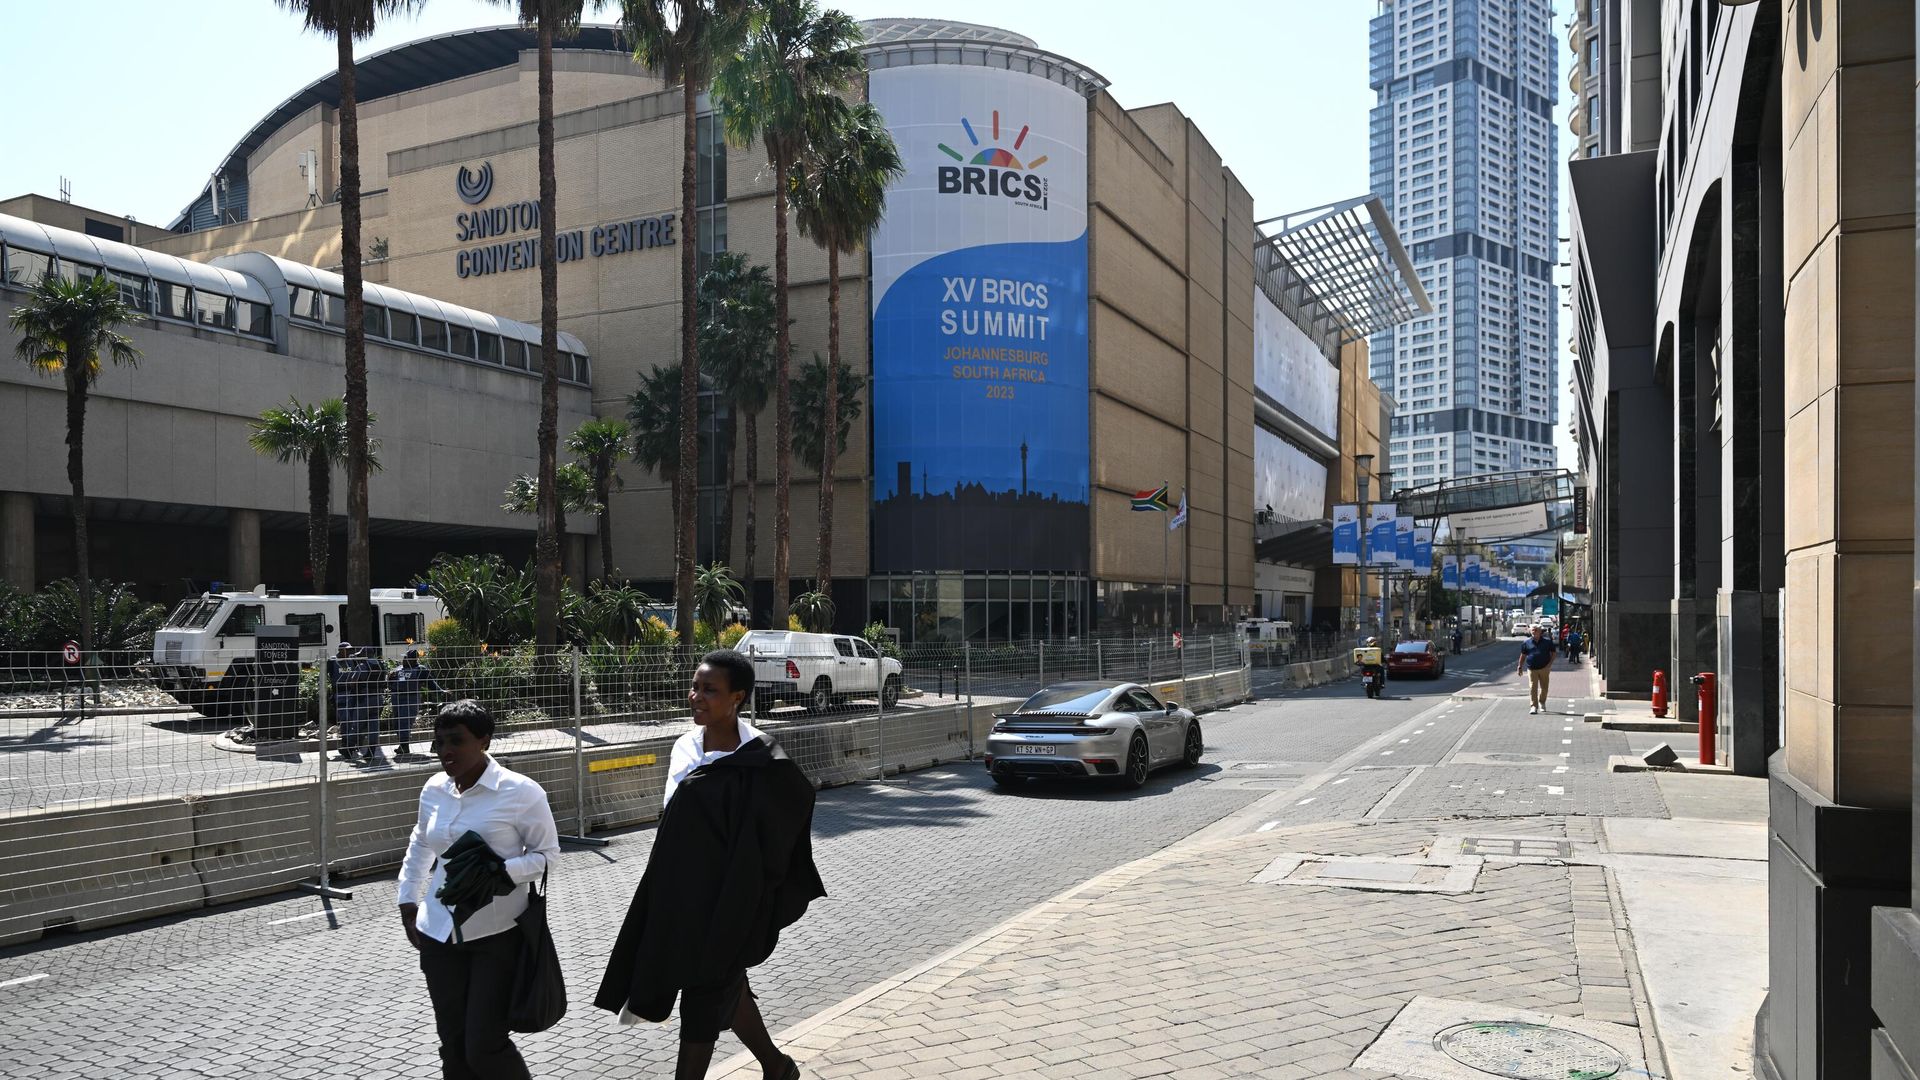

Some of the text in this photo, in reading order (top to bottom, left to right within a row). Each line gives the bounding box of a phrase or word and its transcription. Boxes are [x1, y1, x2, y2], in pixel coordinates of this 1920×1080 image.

[938, 166, 1042, 202] BRICS
[589, 213, 676, 258] CENTRE
[942, 277, 1049, 310] XV BRICS
[941, 309, 1050, 341] SUMMIT
[943, 346, 1049, 366] JOHANNESBURG
[952, 365, 1046, 383] SOUTH AFRICA
[986, 385, 1015, 399] 2023
[261, 642, 290, 650] SANDTON
[264, 651, 288, 659] TOWERS
